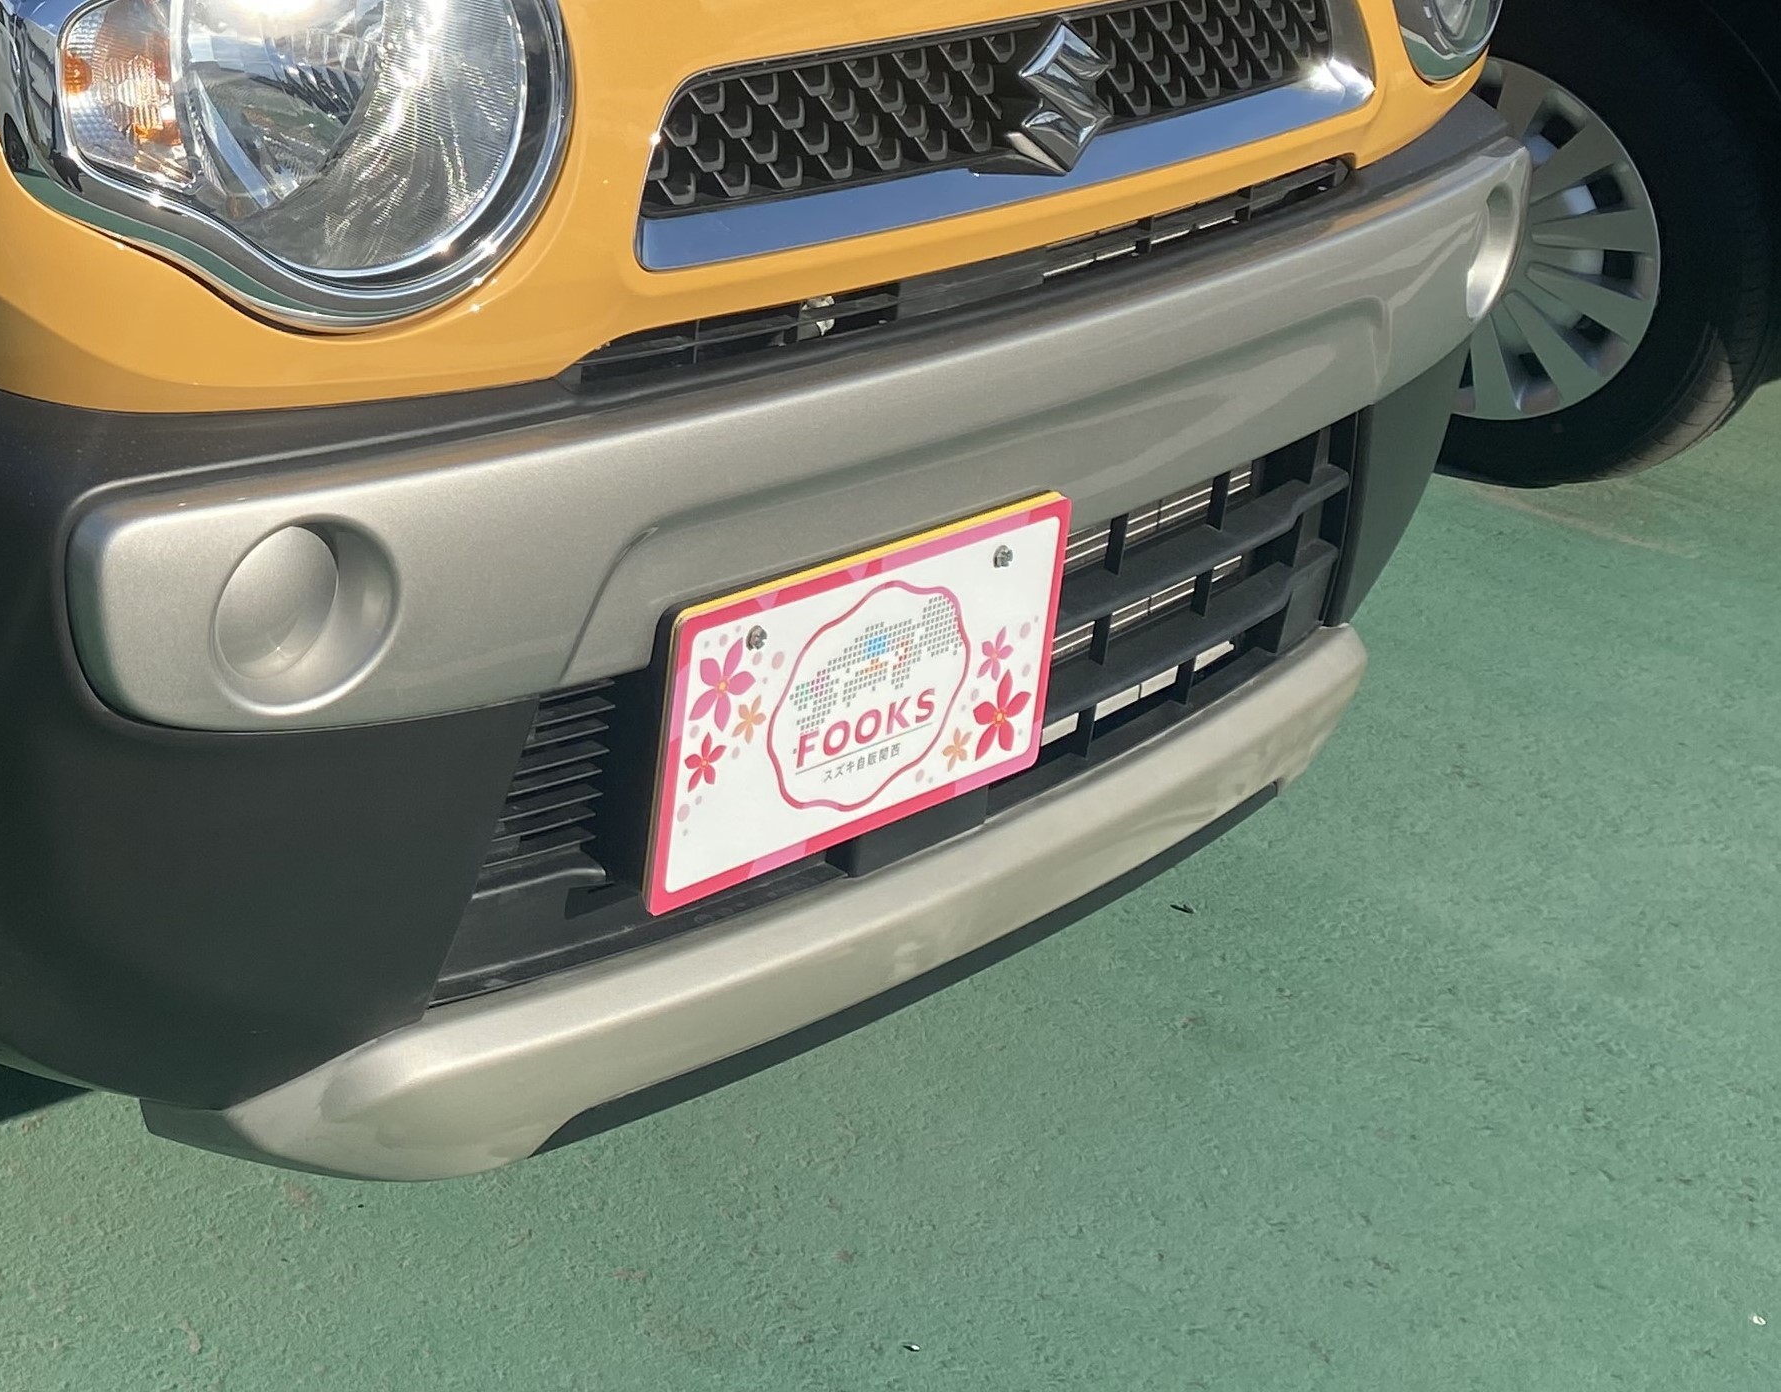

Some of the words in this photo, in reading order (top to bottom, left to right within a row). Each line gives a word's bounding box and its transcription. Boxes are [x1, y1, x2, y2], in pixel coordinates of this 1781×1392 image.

[796, 688, 935, 769] FOOKS
[823, 742, 901, 783] スズキ自販関西
